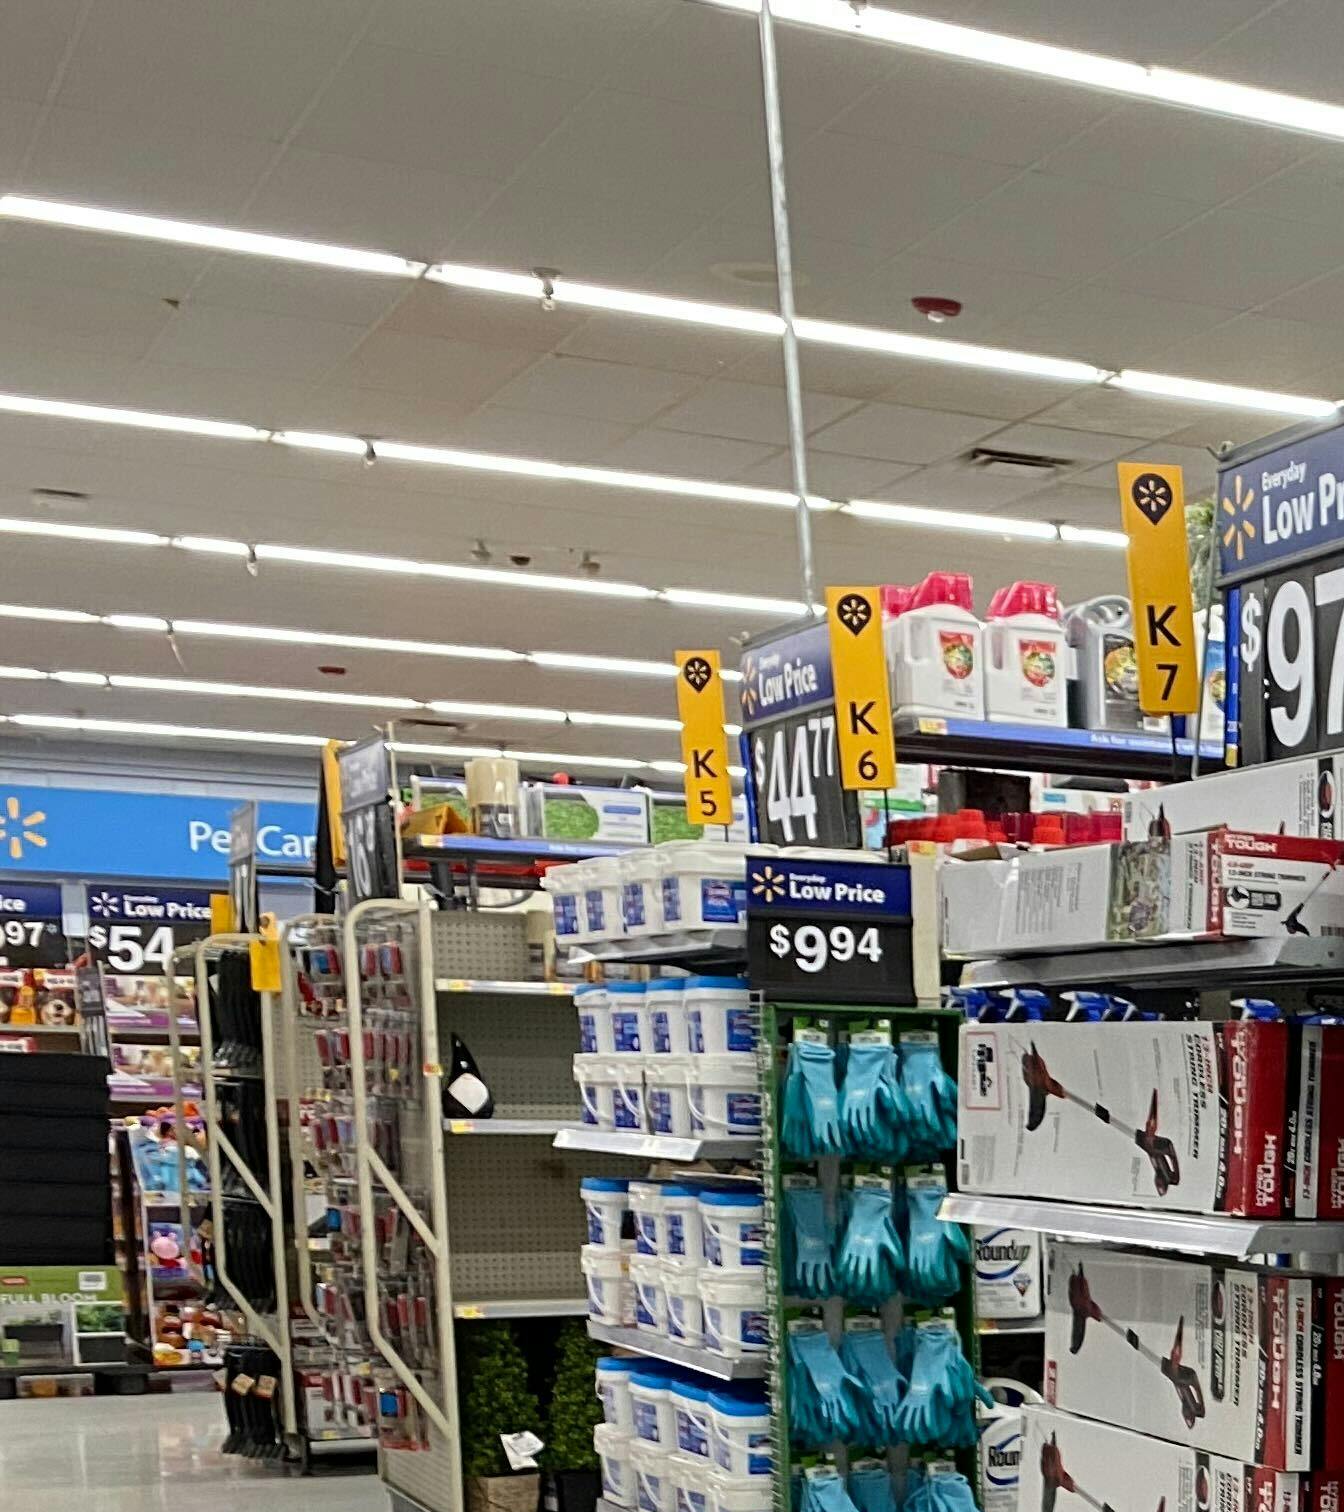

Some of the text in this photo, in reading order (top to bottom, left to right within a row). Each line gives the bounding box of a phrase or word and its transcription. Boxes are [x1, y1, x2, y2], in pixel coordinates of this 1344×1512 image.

[1261, 461, 1307, 492] Everyday
[1261, 489, 1316, 546] Low
[1147, 605, 1182, 649] K
[759, 672, 786, 706] Low
[785, 659, 817, 699] Price
[1157, 664, 1179, 701] 7
[850, 701, 878, 736] K
[692, 748, 717, 779] K
[857, 750, 879, 782] 6
[701, 791, 717, 816] 5
[189, 821, 316, 857] Pe Car
[1227, 839, 1279, 853] TOUGH
[790, 883, 885, 904] Low Price
[124, 901, 212, 920] Low Price
[0, 921, 44, 947] 97
[89, 925, 174, 972] $54
